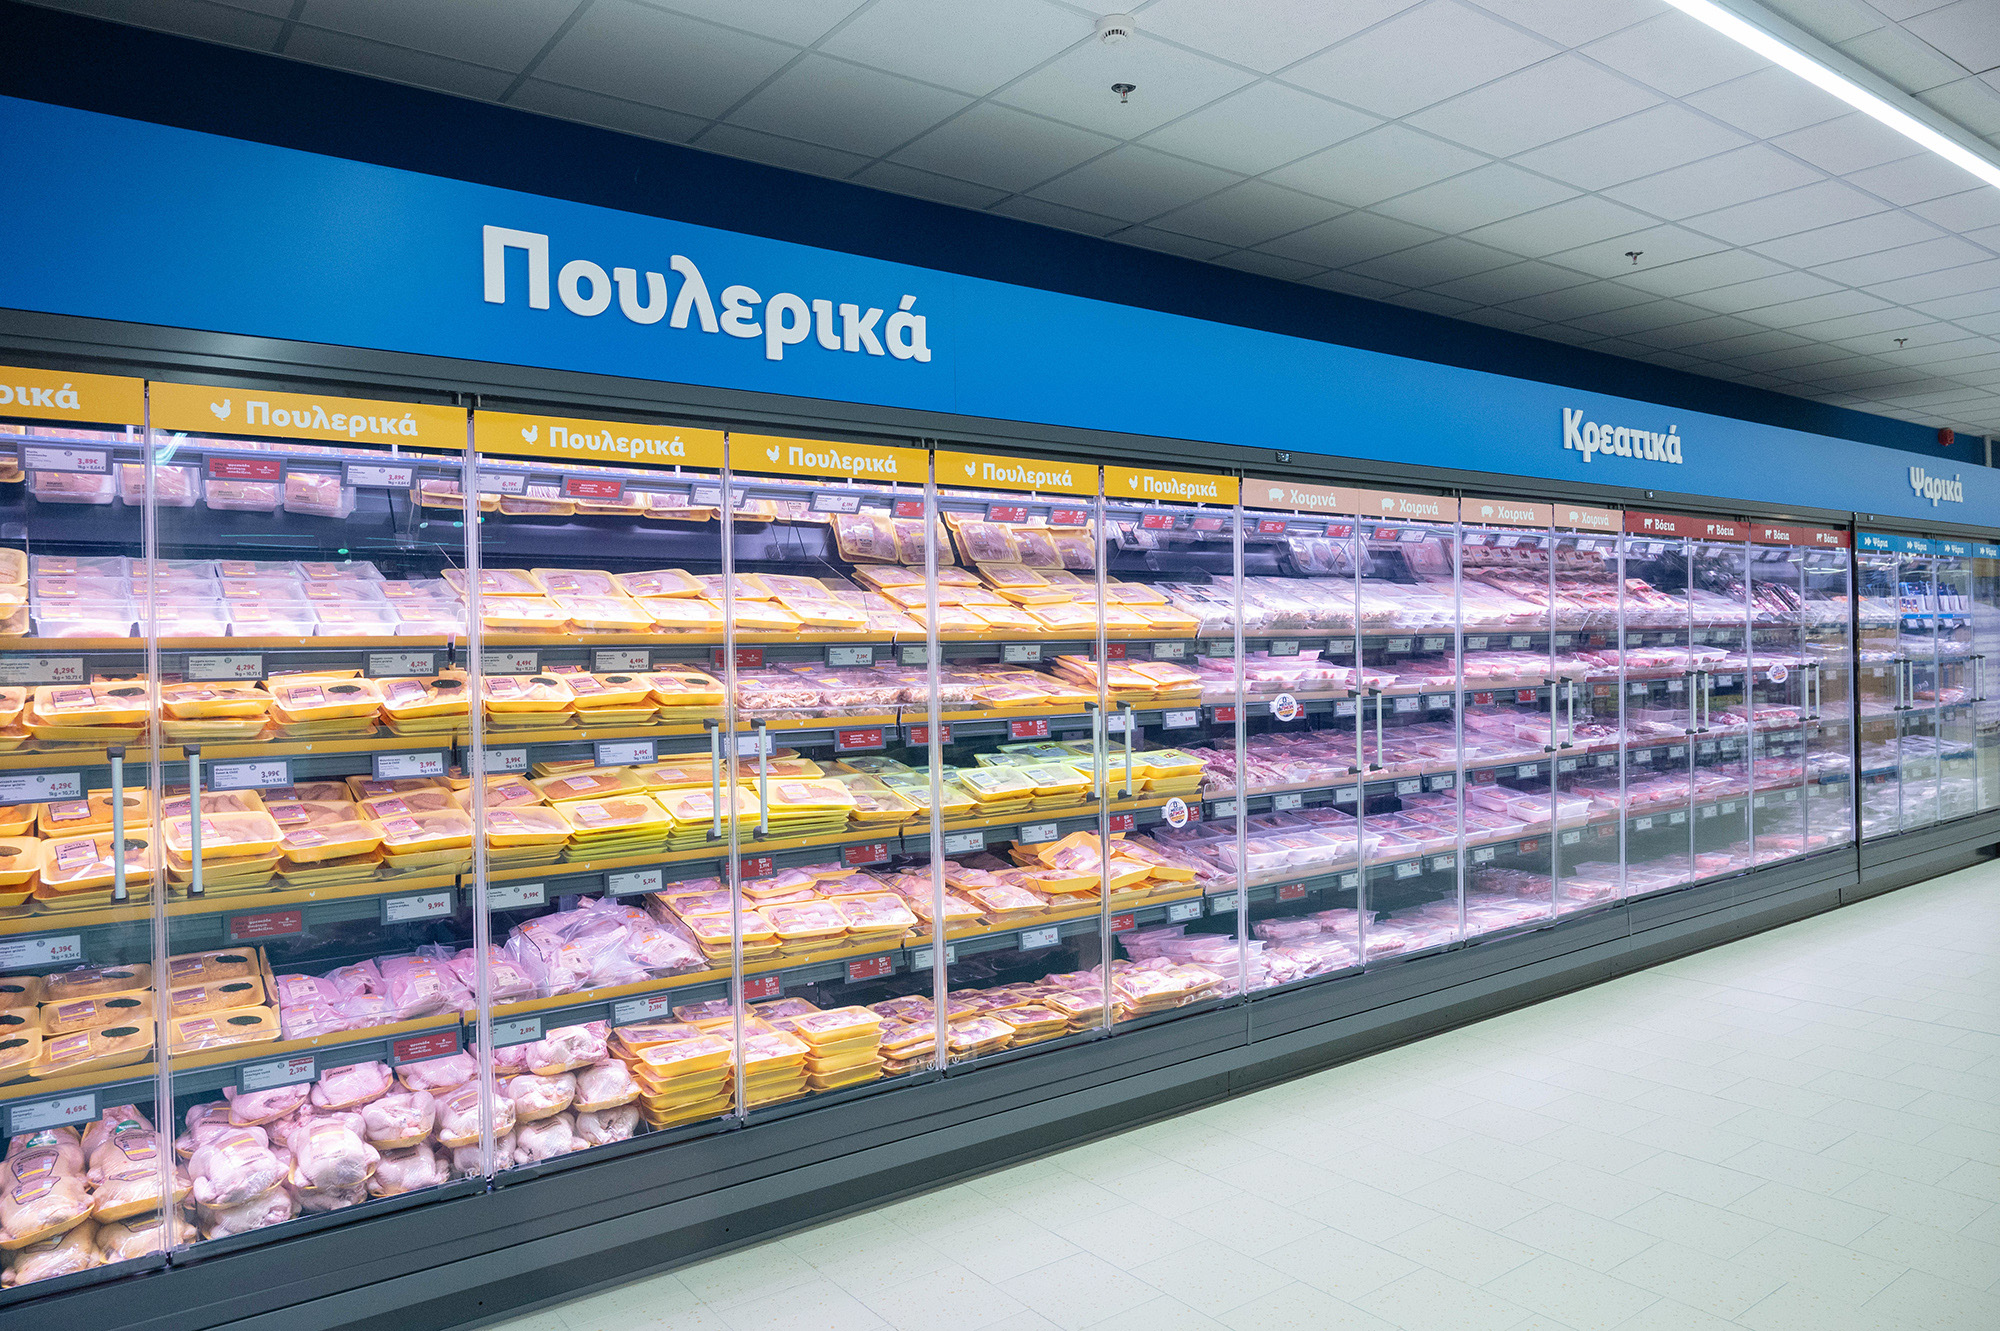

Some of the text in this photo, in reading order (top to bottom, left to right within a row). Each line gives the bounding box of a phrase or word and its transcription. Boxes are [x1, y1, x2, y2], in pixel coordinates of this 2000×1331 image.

[483, 224, 931, 363] Πουλερικά
[246, 400, 418, 437] Πουλερικά
[1562, 407, 1683, 464] Κρεατικά
[549, 426, 686, 458] Πουλερικά
[77, 456, 99, 465] 3,89€
[788, 446, 898, 475] Πουλερικά
[982, 463, 1073, 488] Πουλερικά
[1143, 476, 1218, 499] Πουλερικά
[1909, 466, 1964, 506] Ψαρικά
[1290, 489, 1336, 508] Χοιρινά
[1399, 498, 1439, 517] Χοιρινά
[1497, 505, 1535, 522] Χοιρινά
[1581, 511, 1609, 527] Χοιρινά
[1654, 518, 1675, 531] Βόεια
[1716, 524, 1734, 535] Βόεια
[1773, 529, 1789, 541] Βόεια
[1823, 532, 1838, 543] Βόεια
[1872, 537, 1888, 549] Ψάρια
[54, 667, 75, 675] 4,29€
[236, 664, 256, 672] 4,29€
[419, 761, 436, 769] 3,99€
[261, 770, 280, 778] 3,99€
[50, 782, 72, 790] 4,29€
[523, 891, 538, 900] 9,99€
[428, 901, 445, 910] 9,99€
[50, 945, 72, 955] 4,39€
[289, 1066, 308, 1075] 2,39€
[65, 1104, 87, 1114] 4,69€
